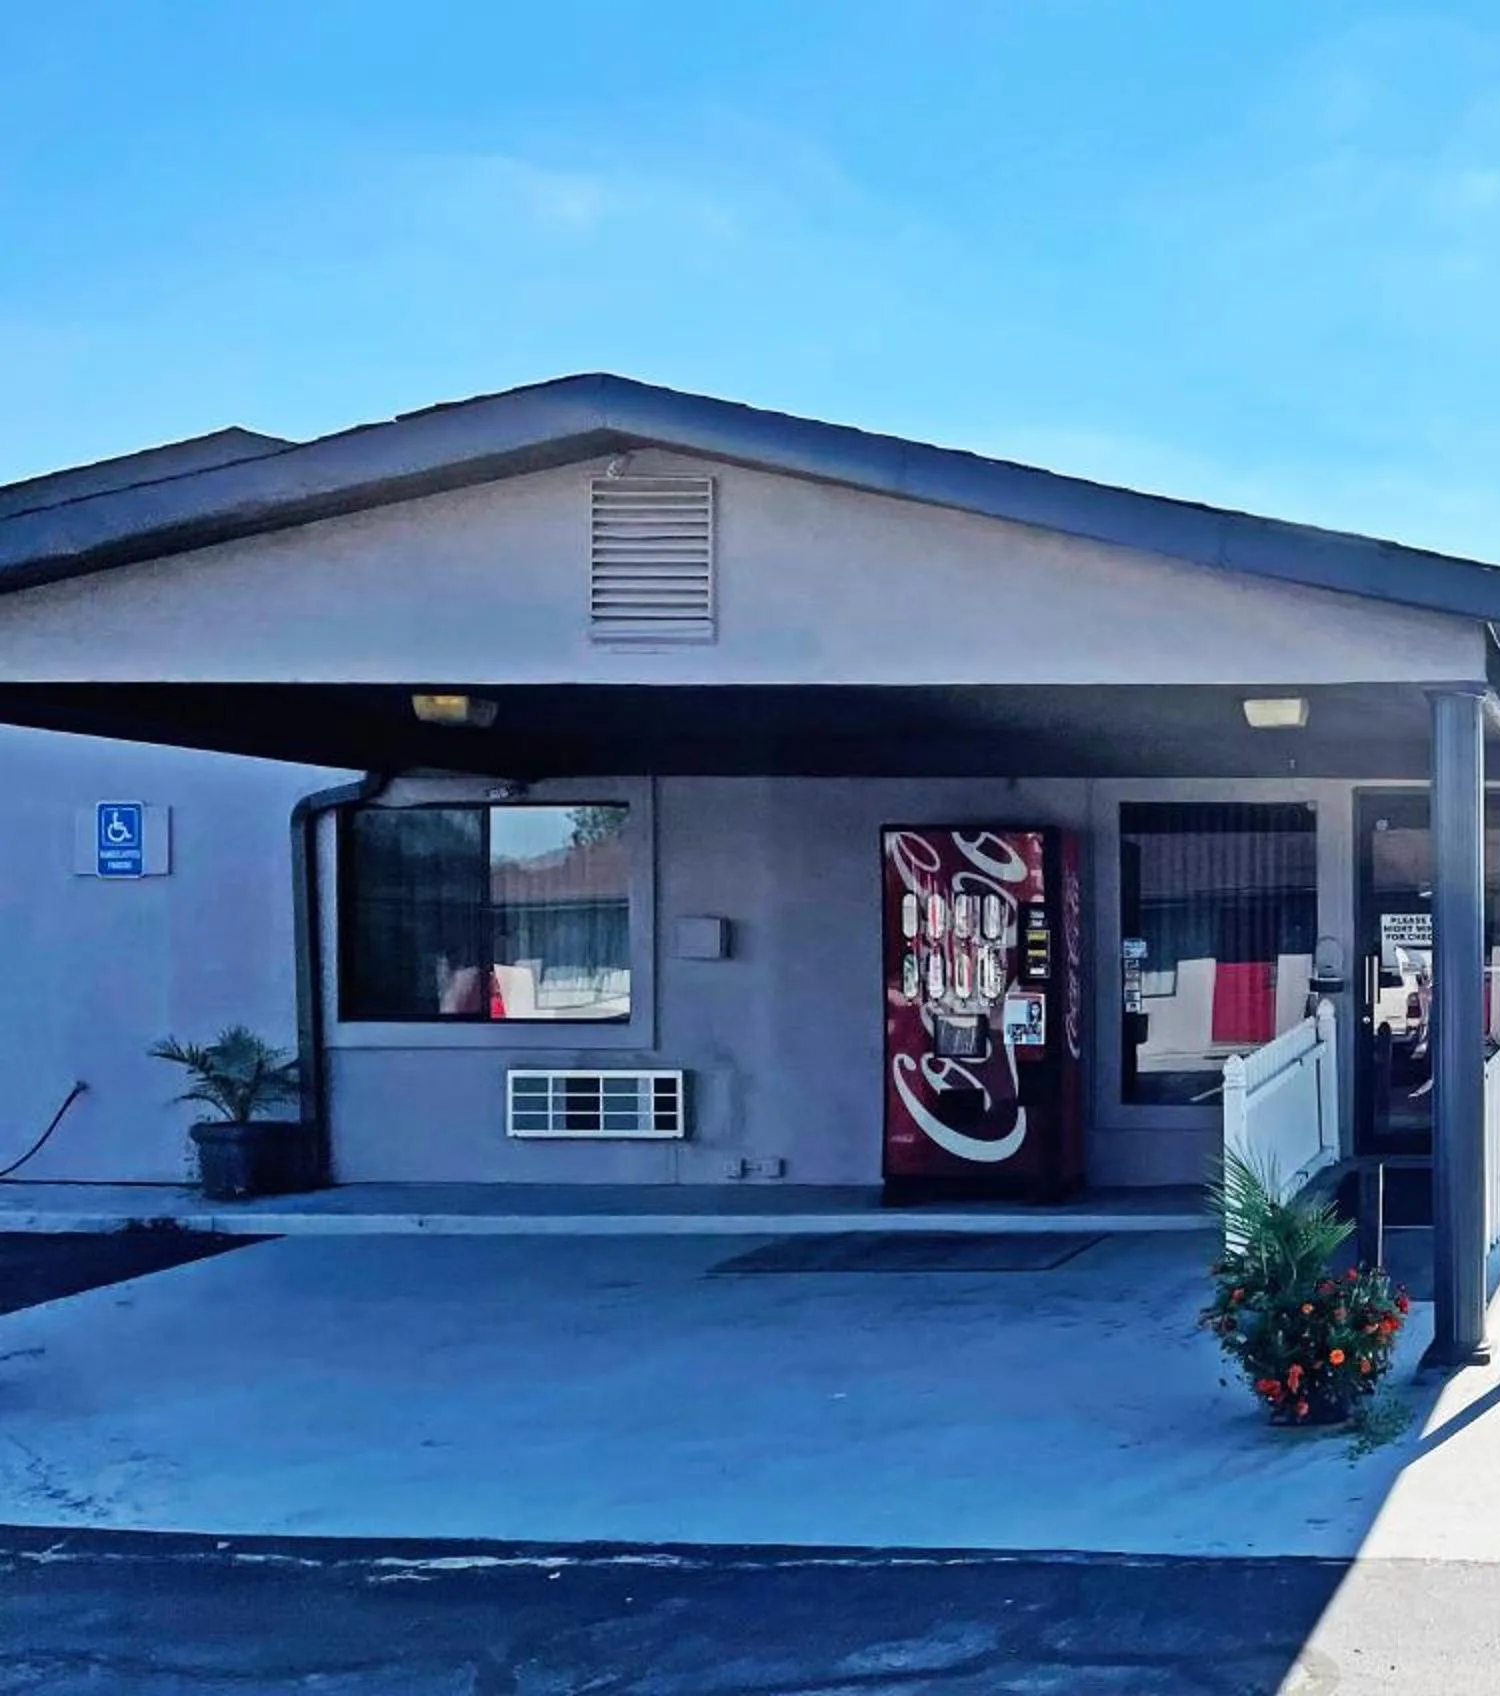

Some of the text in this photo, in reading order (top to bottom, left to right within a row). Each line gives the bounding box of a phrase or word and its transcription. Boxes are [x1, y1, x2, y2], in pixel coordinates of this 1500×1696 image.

[1391, 917, 1427, 925] PLEASE
[1386, 933, 1432, 941] FOR CHEC
